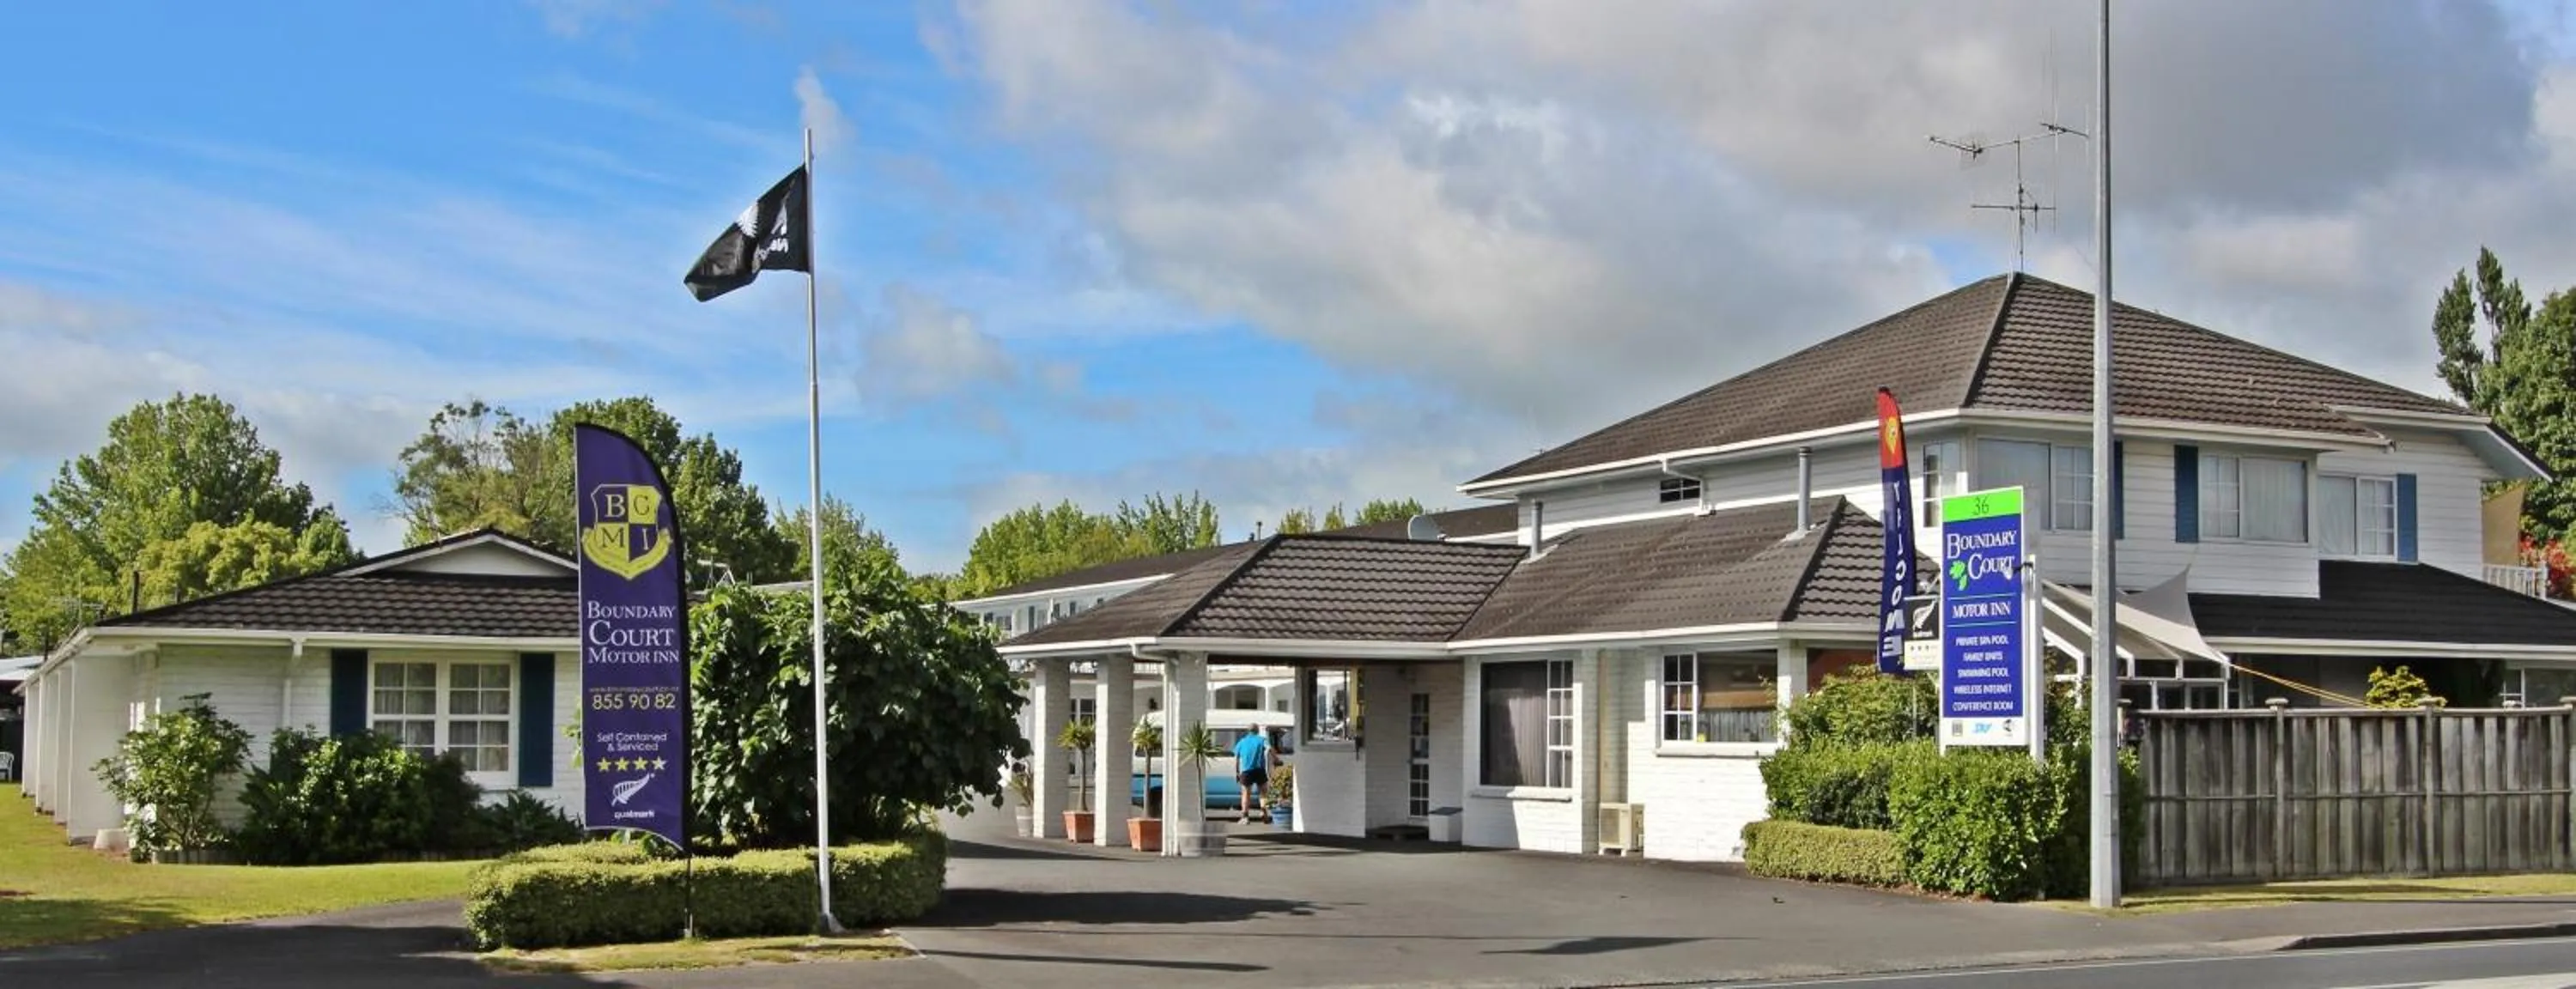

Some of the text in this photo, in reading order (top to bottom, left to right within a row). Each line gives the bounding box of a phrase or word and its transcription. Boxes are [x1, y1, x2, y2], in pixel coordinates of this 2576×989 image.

[1972, 496, 1990, 515] 36
[1947, 531, 2017, 560] BOUNDARY
[1968, 553, 2014, 580] COURT
[587, 600, 677, 619] BOUNDARY
[1952, 602, 2012, 619] MOTOR INN
[588, 619, 675, 646] COURT
[1991, 634, 2009, 645] POOL
[587, 646, 679, 664] MOTOR INN
[1991, 667, 2009, 677] POOL
[592, 693, 676, 710] 855 90 82
[1993, 700, 2014, 711] ROOM
[616, 732, 667, 742] Contained
[617, 742, 659, 752] Serviced
